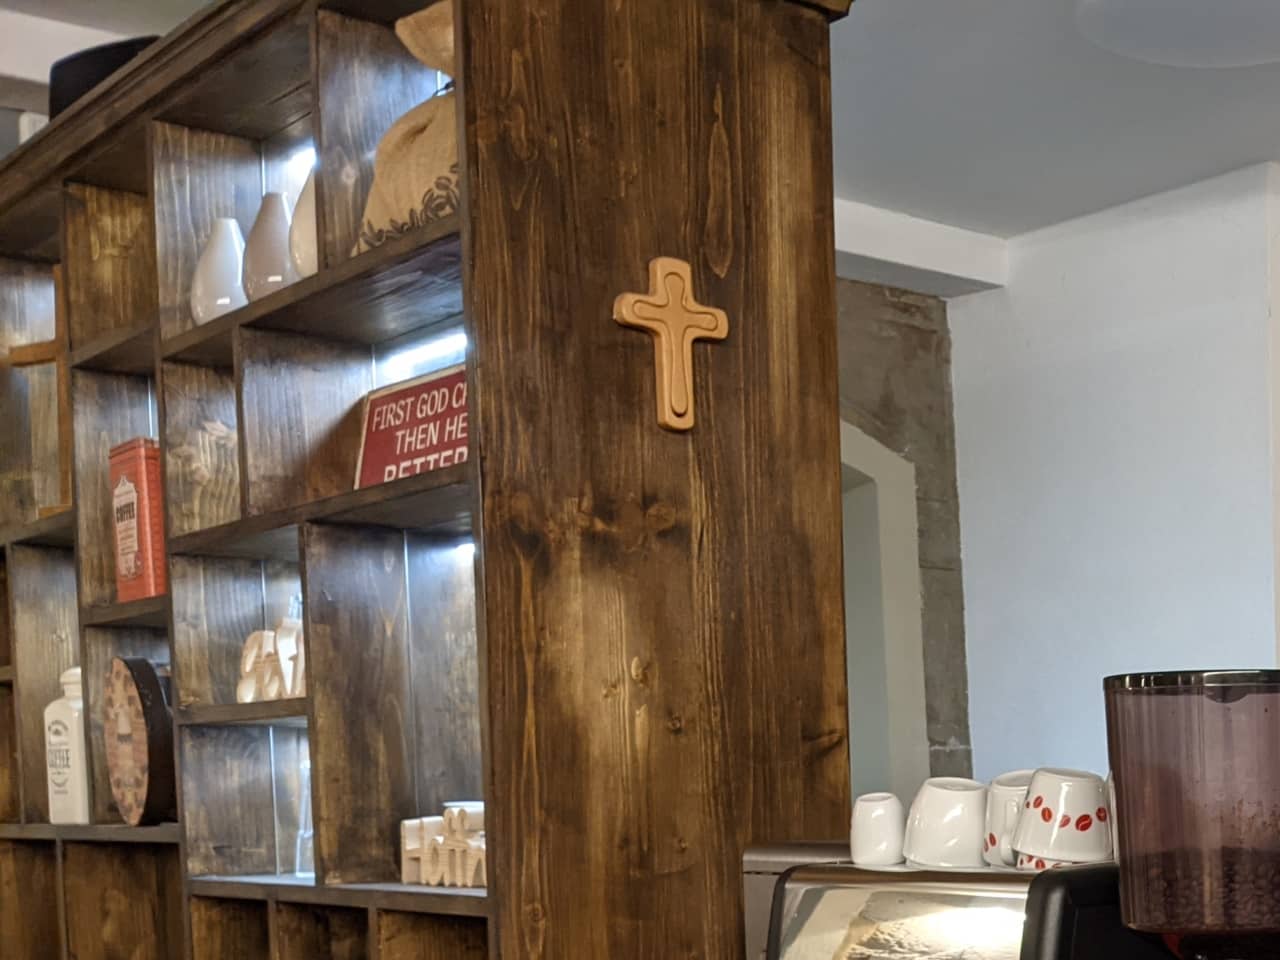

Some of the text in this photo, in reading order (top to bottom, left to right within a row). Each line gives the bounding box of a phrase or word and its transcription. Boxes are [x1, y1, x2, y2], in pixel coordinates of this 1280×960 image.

[372, 396, 415, 432] FIRST
[416, 387, 449, 419] GOD
[396, 412, 468, 456] THEN HE
